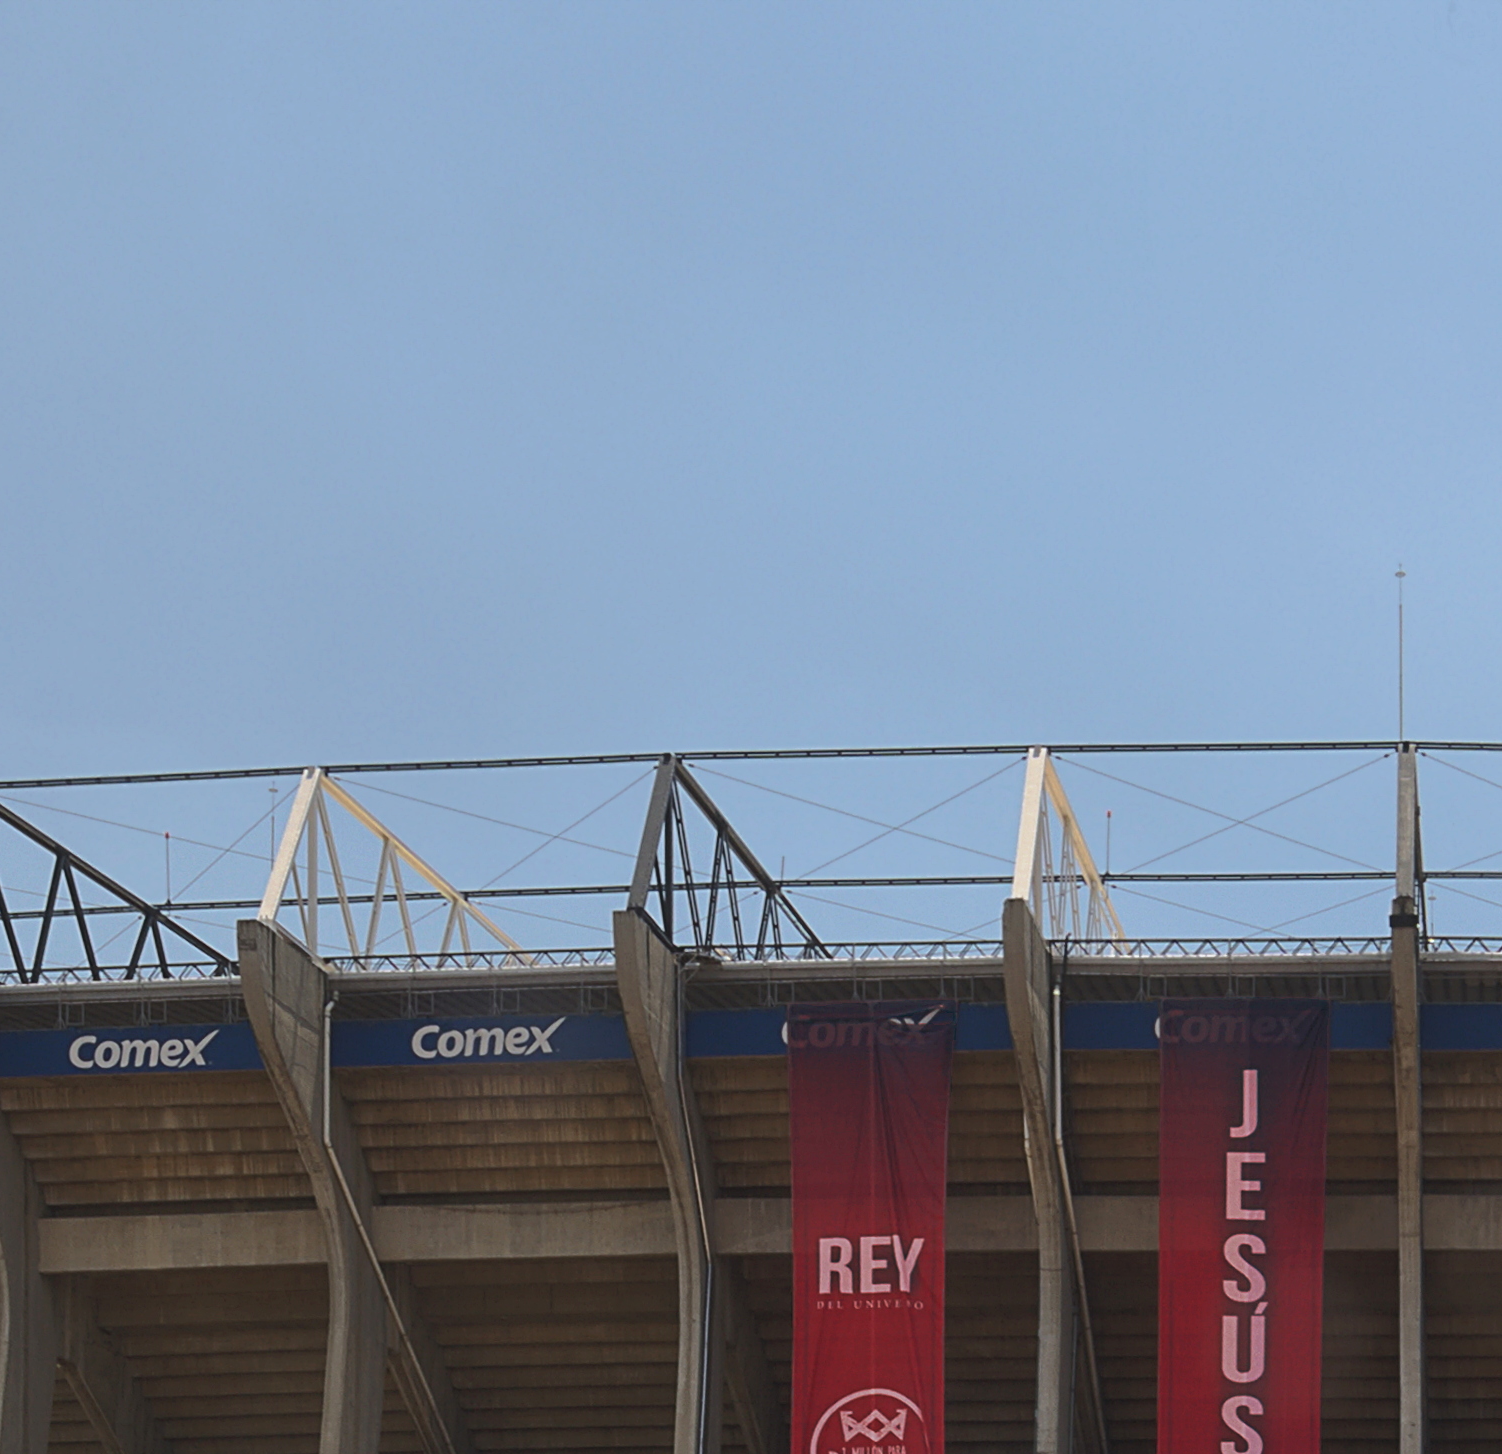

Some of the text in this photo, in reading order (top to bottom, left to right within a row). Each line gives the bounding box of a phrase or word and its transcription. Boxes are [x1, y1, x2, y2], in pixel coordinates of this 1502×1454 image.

[69, 1030, 219, 1069] Comex
[411, 1017, 565, 1059] Comex
[818, 1234, 925, 1294] REY
